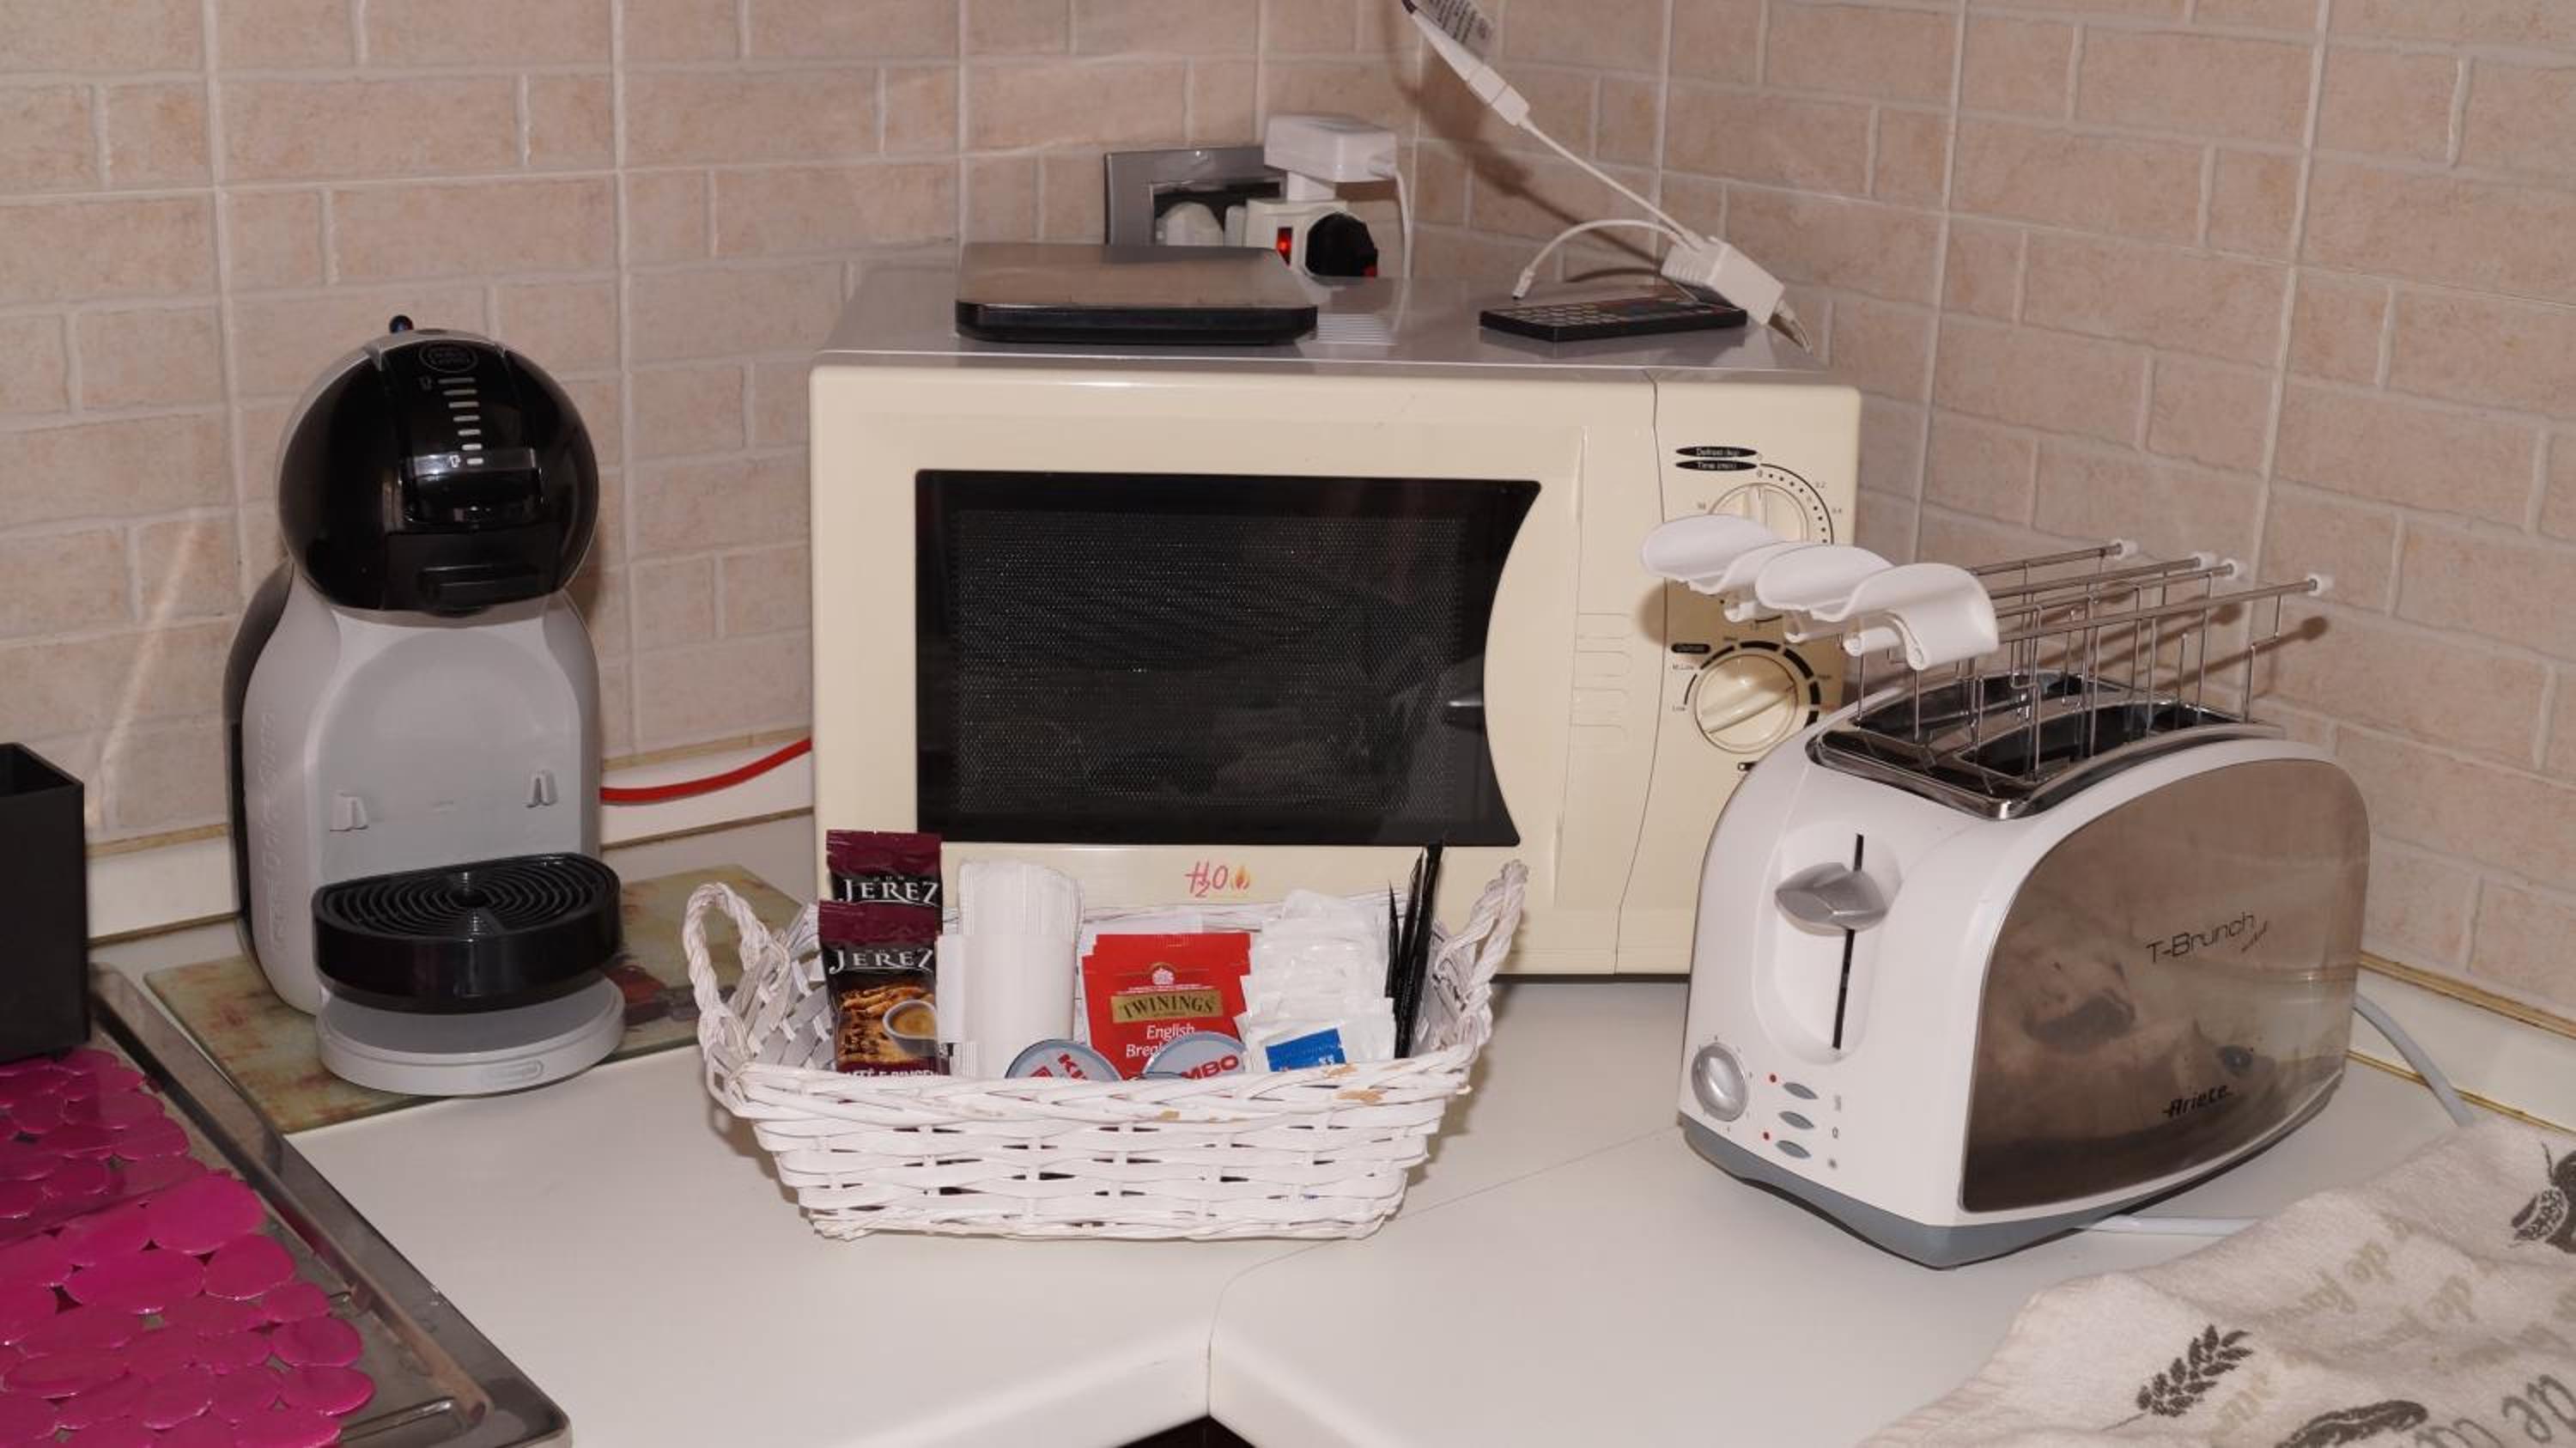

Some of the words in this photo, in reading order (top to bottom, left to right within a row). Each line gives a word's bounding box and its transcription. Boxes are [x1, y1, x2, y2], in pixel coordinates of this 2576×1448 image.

[838, 879, 939, 906] JEREZ
[2146, 911, 2254, 964] T-Brunch
[829, 948, 933, 975] JEREZ
[1119, 992, 1217, 1019] TWININGS
[1146, 1022, 1196, 1043] English
